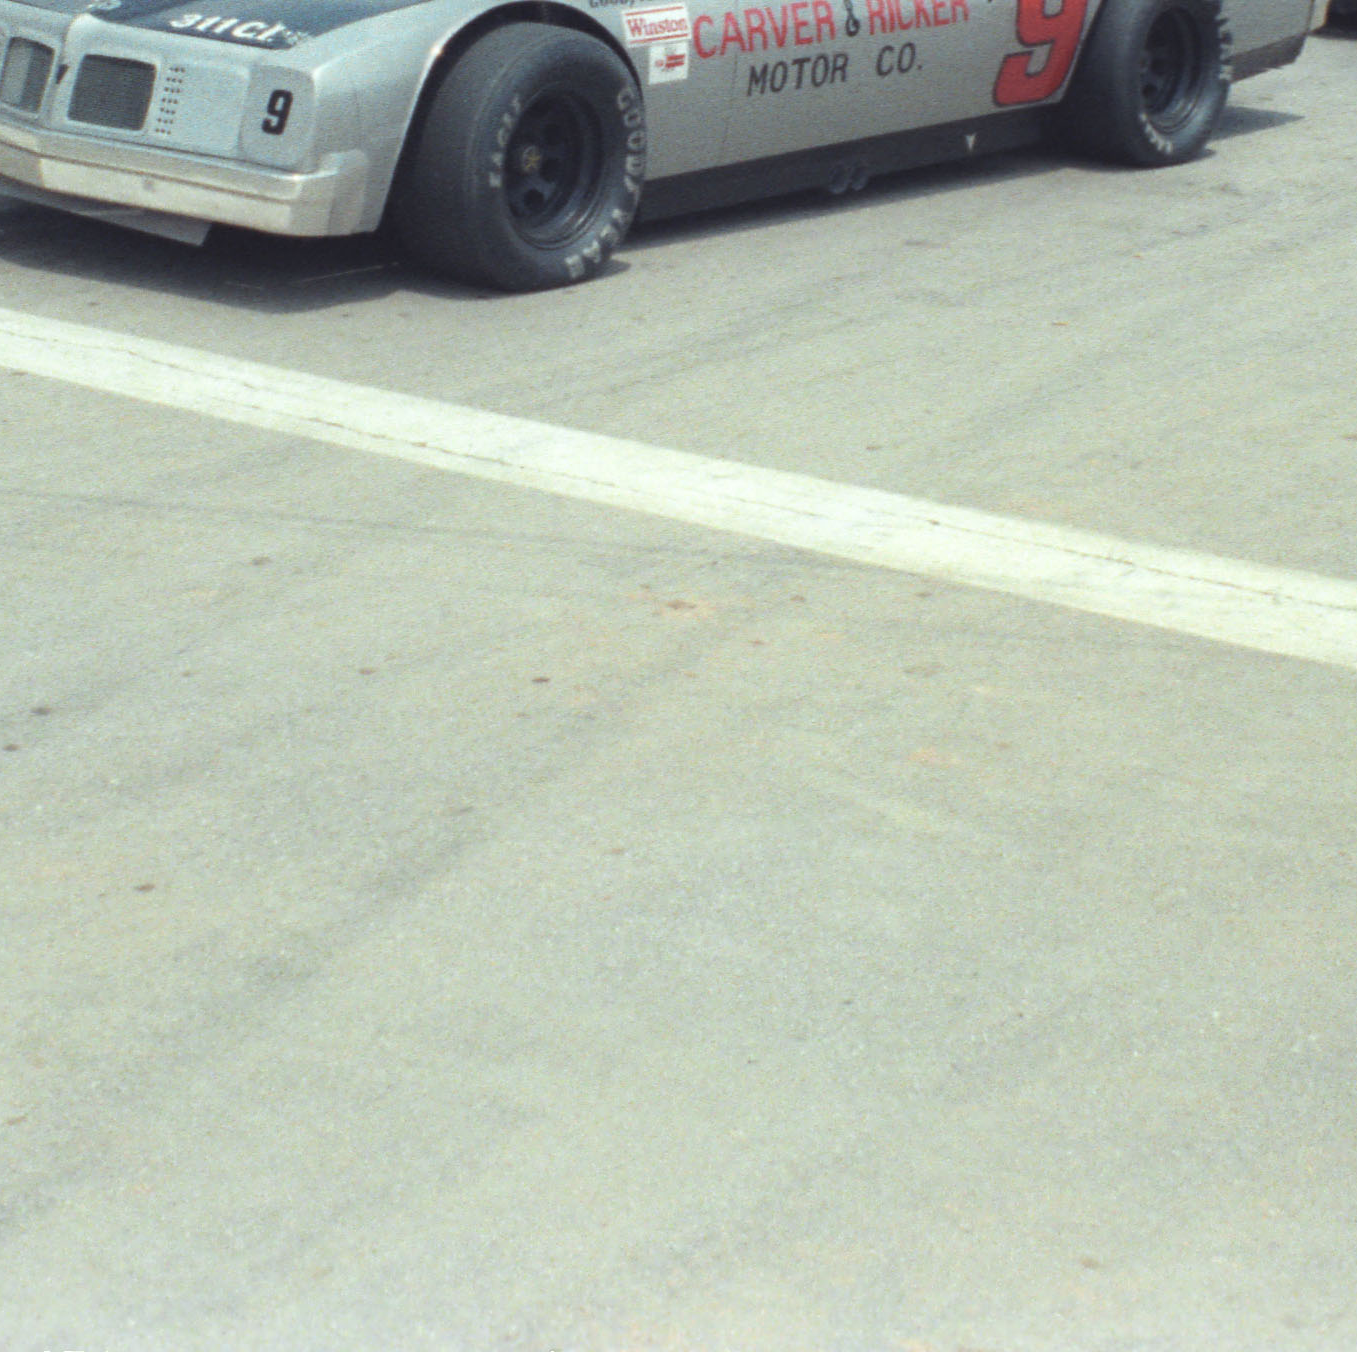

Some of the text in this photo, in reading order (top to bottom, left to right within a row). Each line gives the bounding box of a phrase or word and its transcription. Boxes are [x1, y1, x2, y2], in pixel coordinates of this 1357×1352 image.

[627, 16, 688, 38] Winston
[747, 43, 924, 97] MOTOR CO.
[261, 89, 293, 136] 9
[564, 86, 645, 280] GOODYEAR
